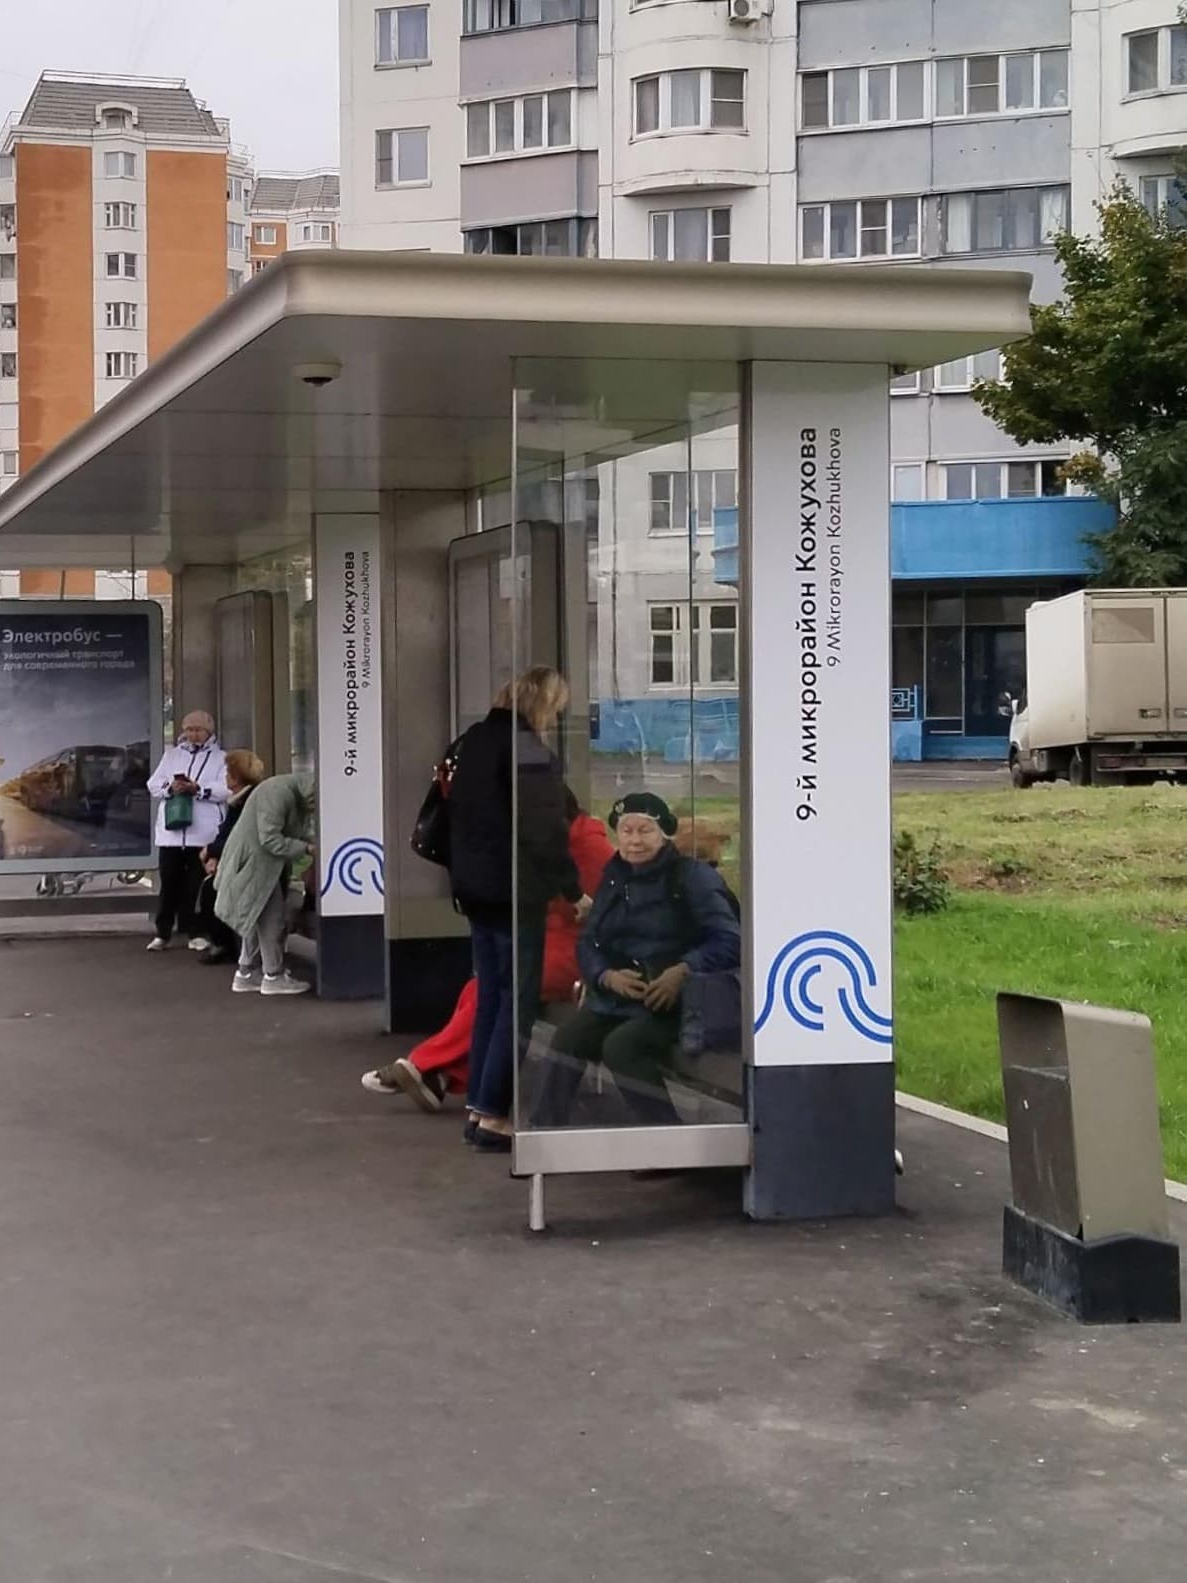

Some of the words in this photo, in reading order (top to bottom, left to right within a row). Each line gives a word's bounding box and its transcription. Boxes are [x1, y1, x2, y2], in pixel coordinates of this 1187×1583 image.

[795, 427, 822, 572] Кожухова
[825, 427, 842, 538] Kozhukhova
[342, 551, 359, 635] Кожухова
[360, 551, 370, 615] Kozhukhova
[826, 544, 845, 651] Mikrorayon
[2, 627, 101, 645] Электробус
[361, 618, 372, 679] Mikrorayon
[826, 656, 841, 667] 9
[343, 639, 360, 744] микрорайон
[796, 583, 822, 764] микрорайон
[344, 750, 358, 777] 9-й
[796, 776, 817, 821] 9-й
